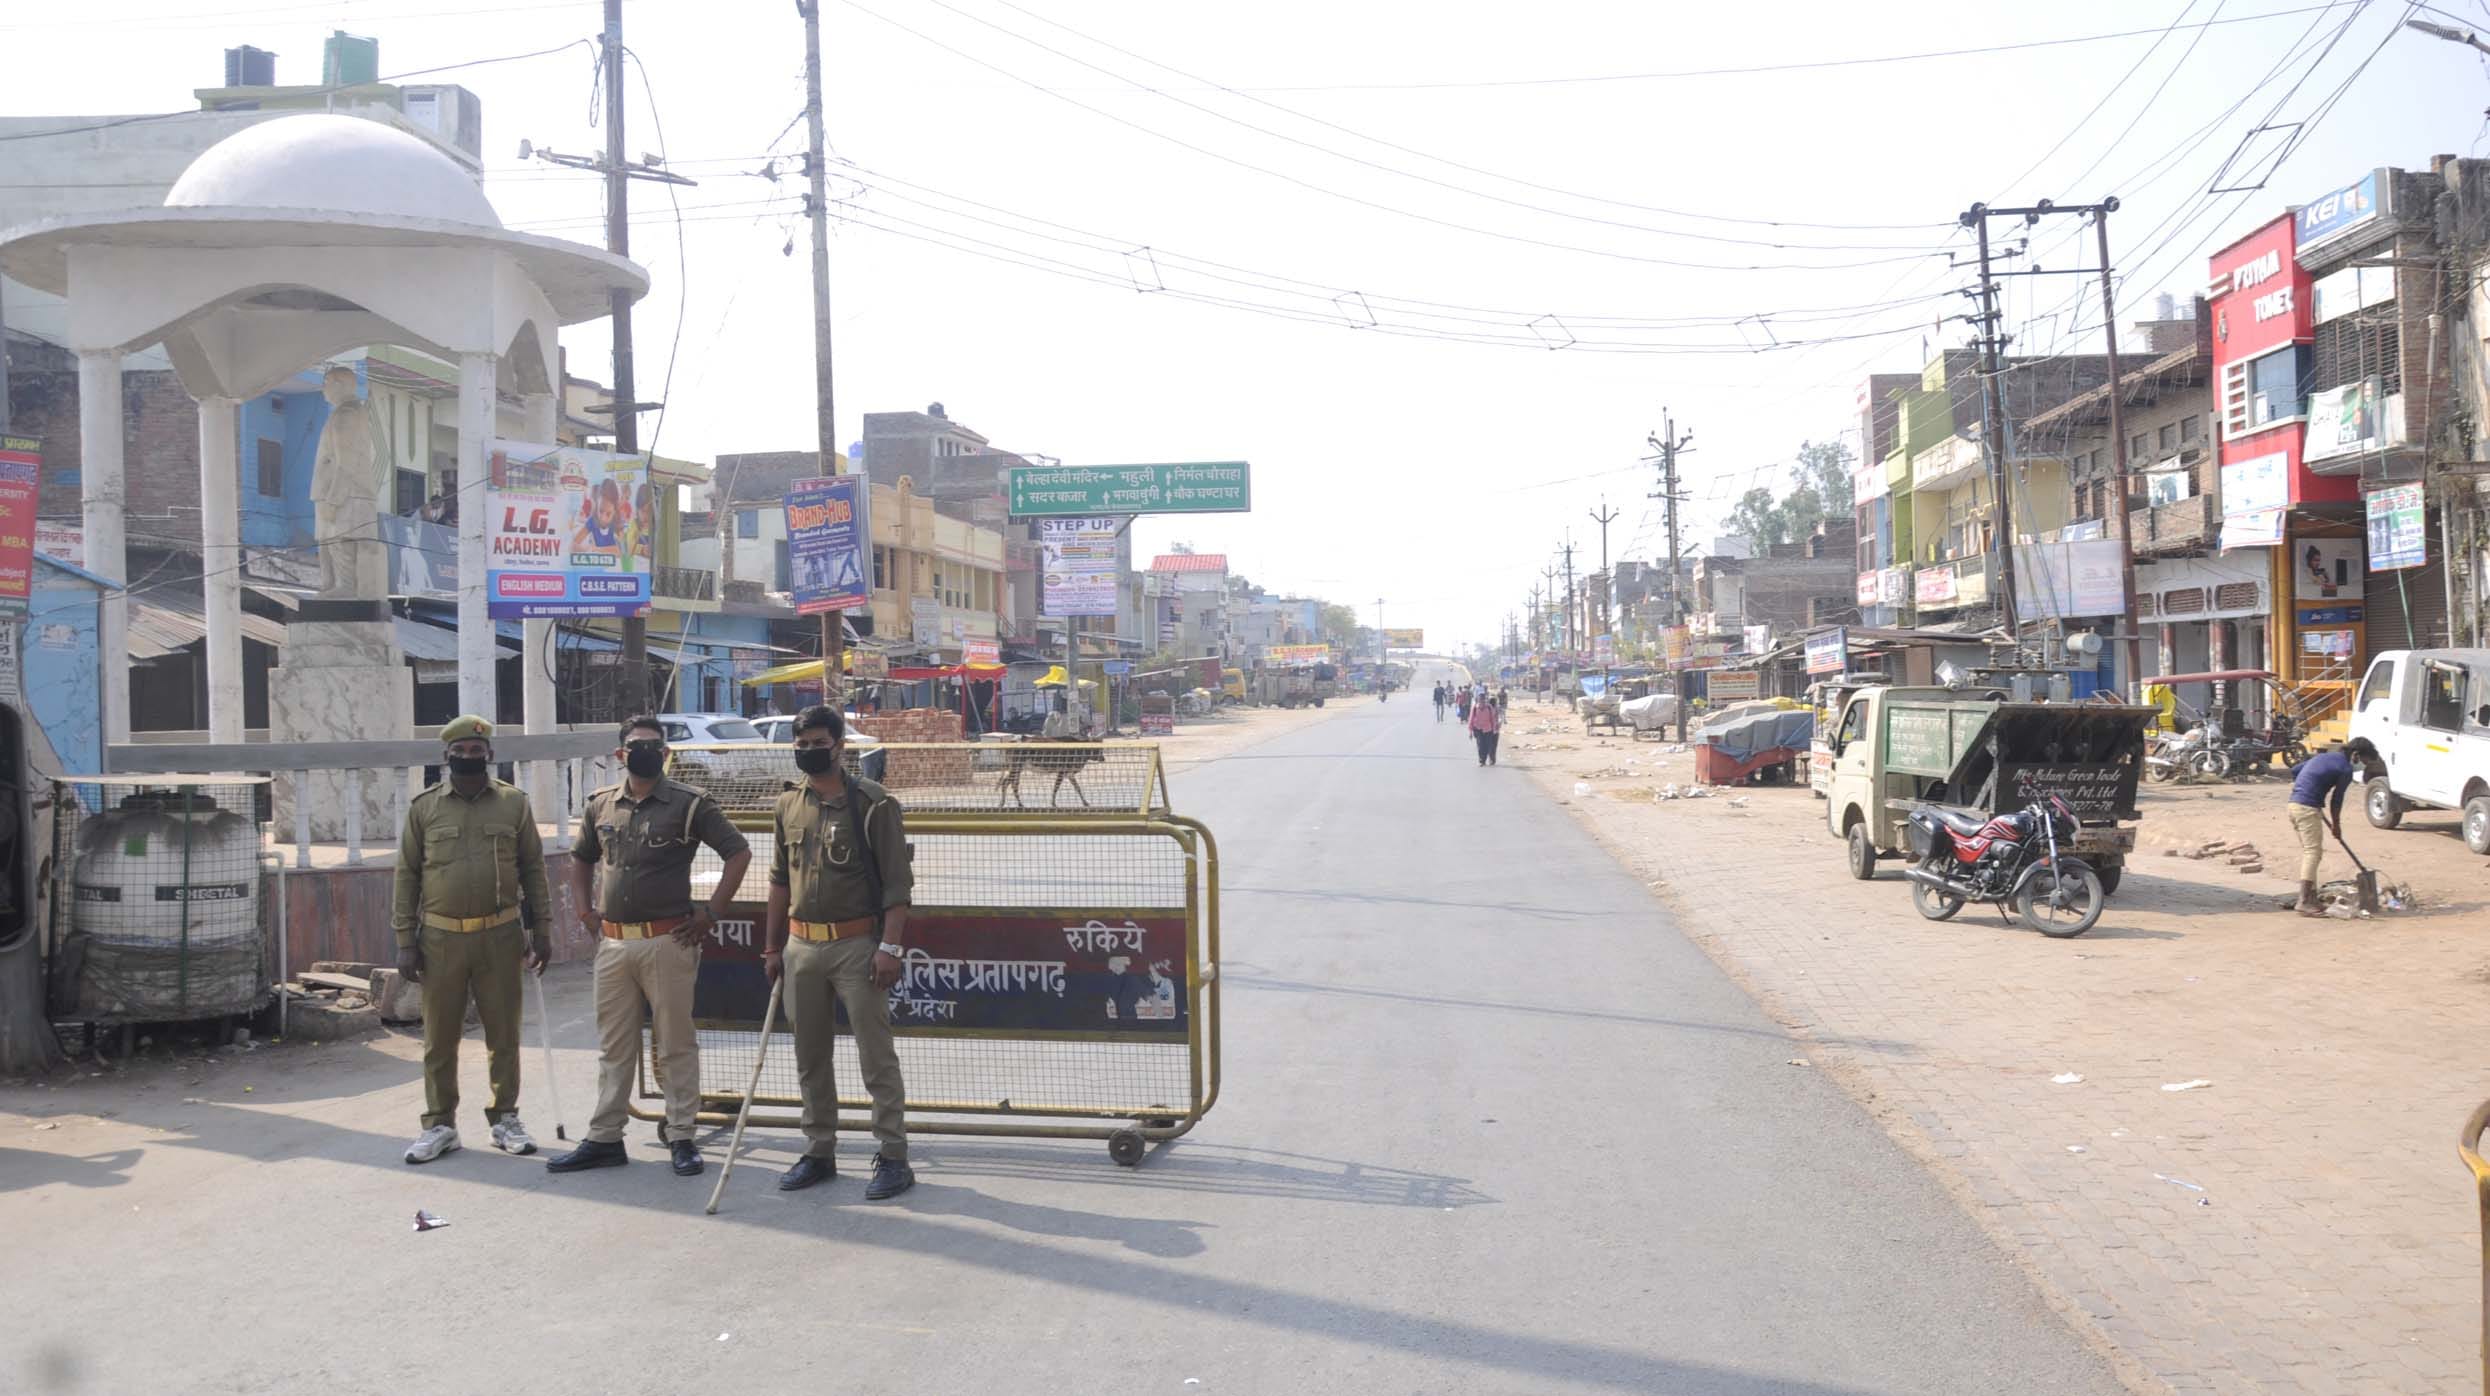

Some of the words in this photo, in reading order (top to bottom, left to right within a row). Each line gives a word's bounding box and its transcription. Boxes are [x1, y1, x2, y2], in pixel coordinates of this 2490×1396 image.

[2305, 193, 2341, 228] KEI
[502, 506, 556, 535] L.G.
[787, 498, 852, 530] BRAND-HUB
[1044, 520, 1085, 531] STEP
[1091, 520, 1113, 530] UP
[493, 536, 561, 557] ACADEMY
[501, 580, 532, 591] ENGLISH
[534, 581, 563, 592] MEDIUM
[607, 581, 636, 592] PATTERN
[2096, 769, 2121, 781] Tools
[1063, 920, 1147, 952] रुकिये
[964, 959, 1067, 998] प्रतापगढ़
